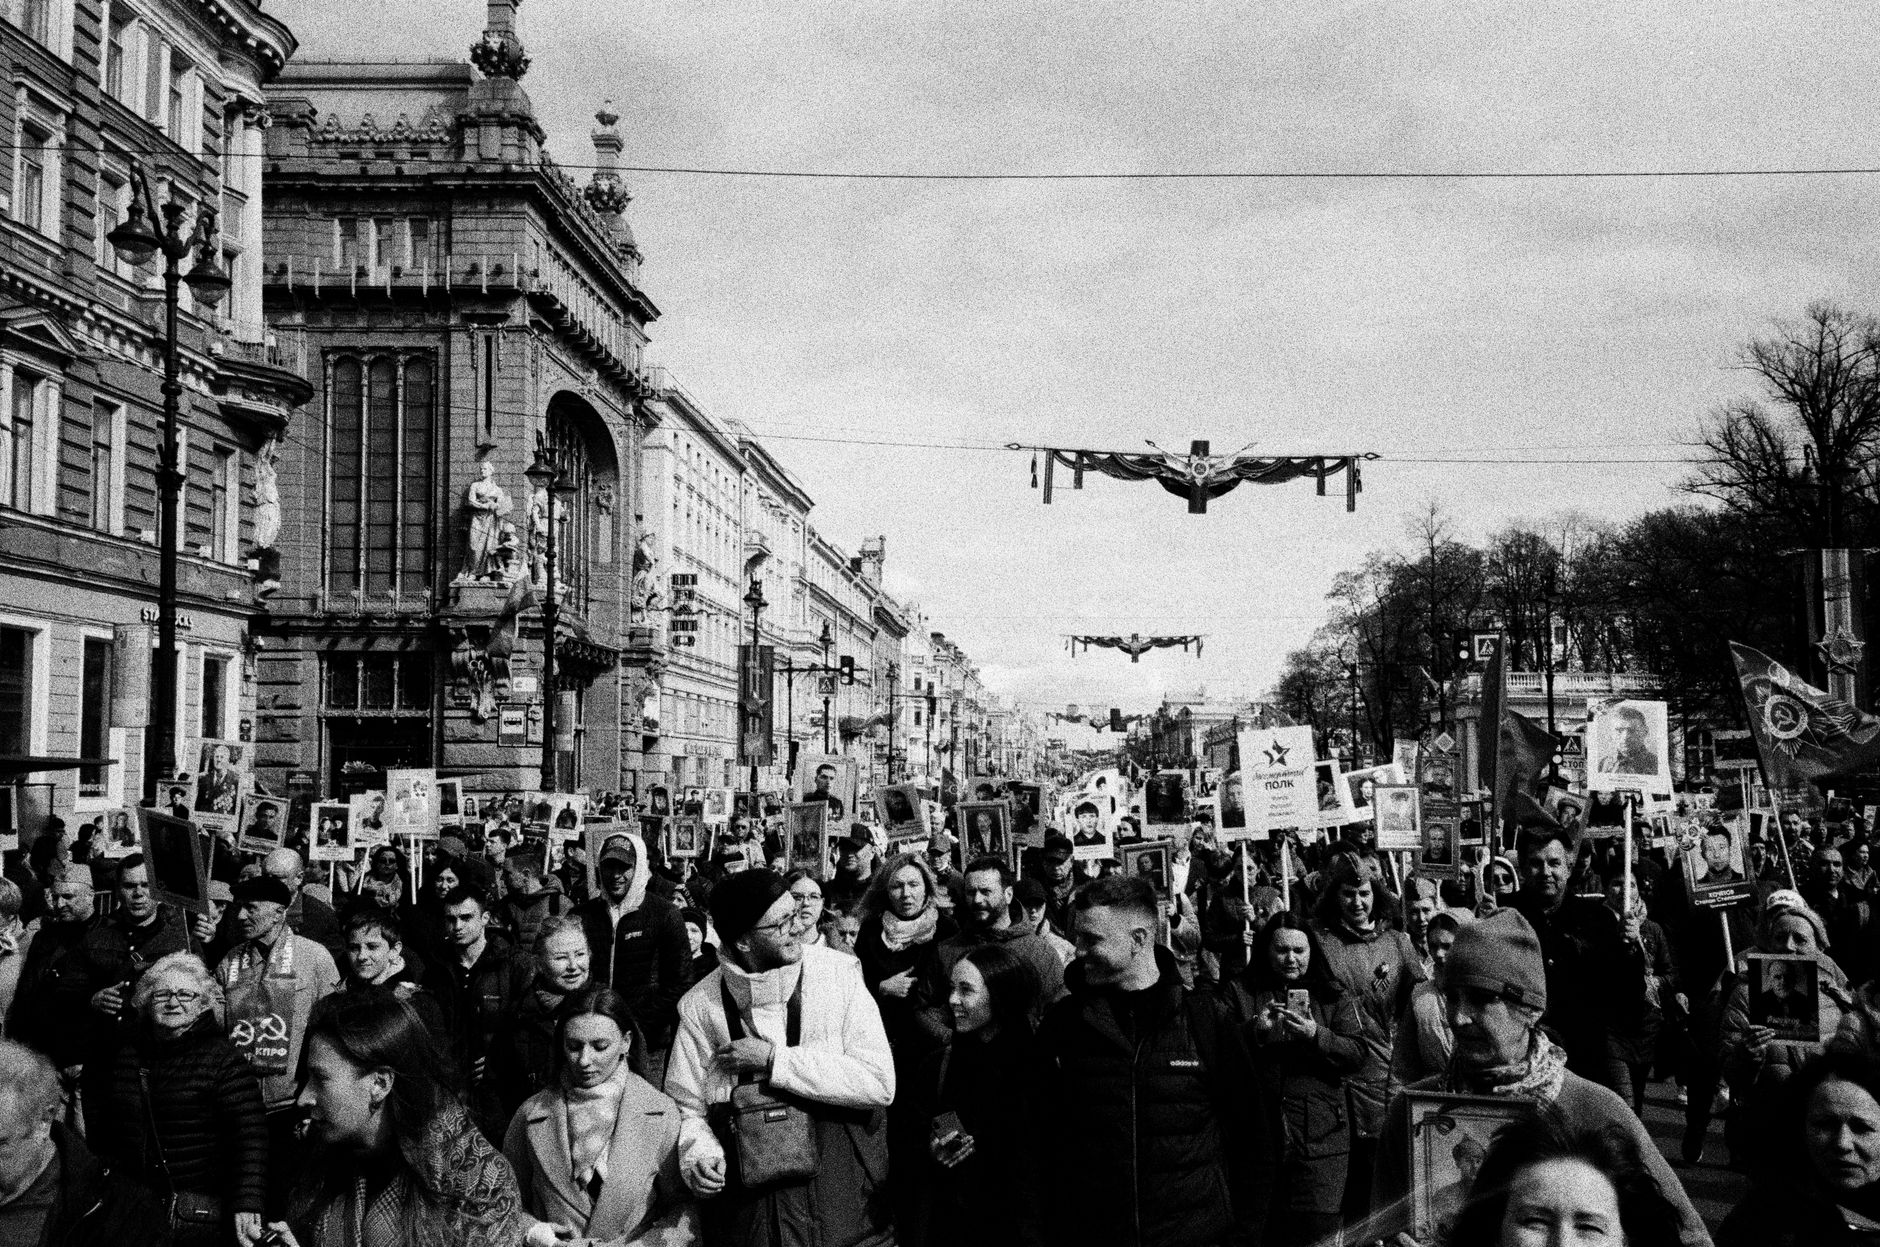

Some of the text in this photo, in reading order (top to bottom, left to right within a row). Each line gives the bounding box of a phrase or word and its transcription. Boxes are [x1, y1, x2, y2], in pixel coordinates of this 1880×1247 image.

[1265, 780, 1294, 790] ПОЛК
[255, 1047, 288, 1058] КПРФ
[1169, 1059, 1192, 1067] adidas
